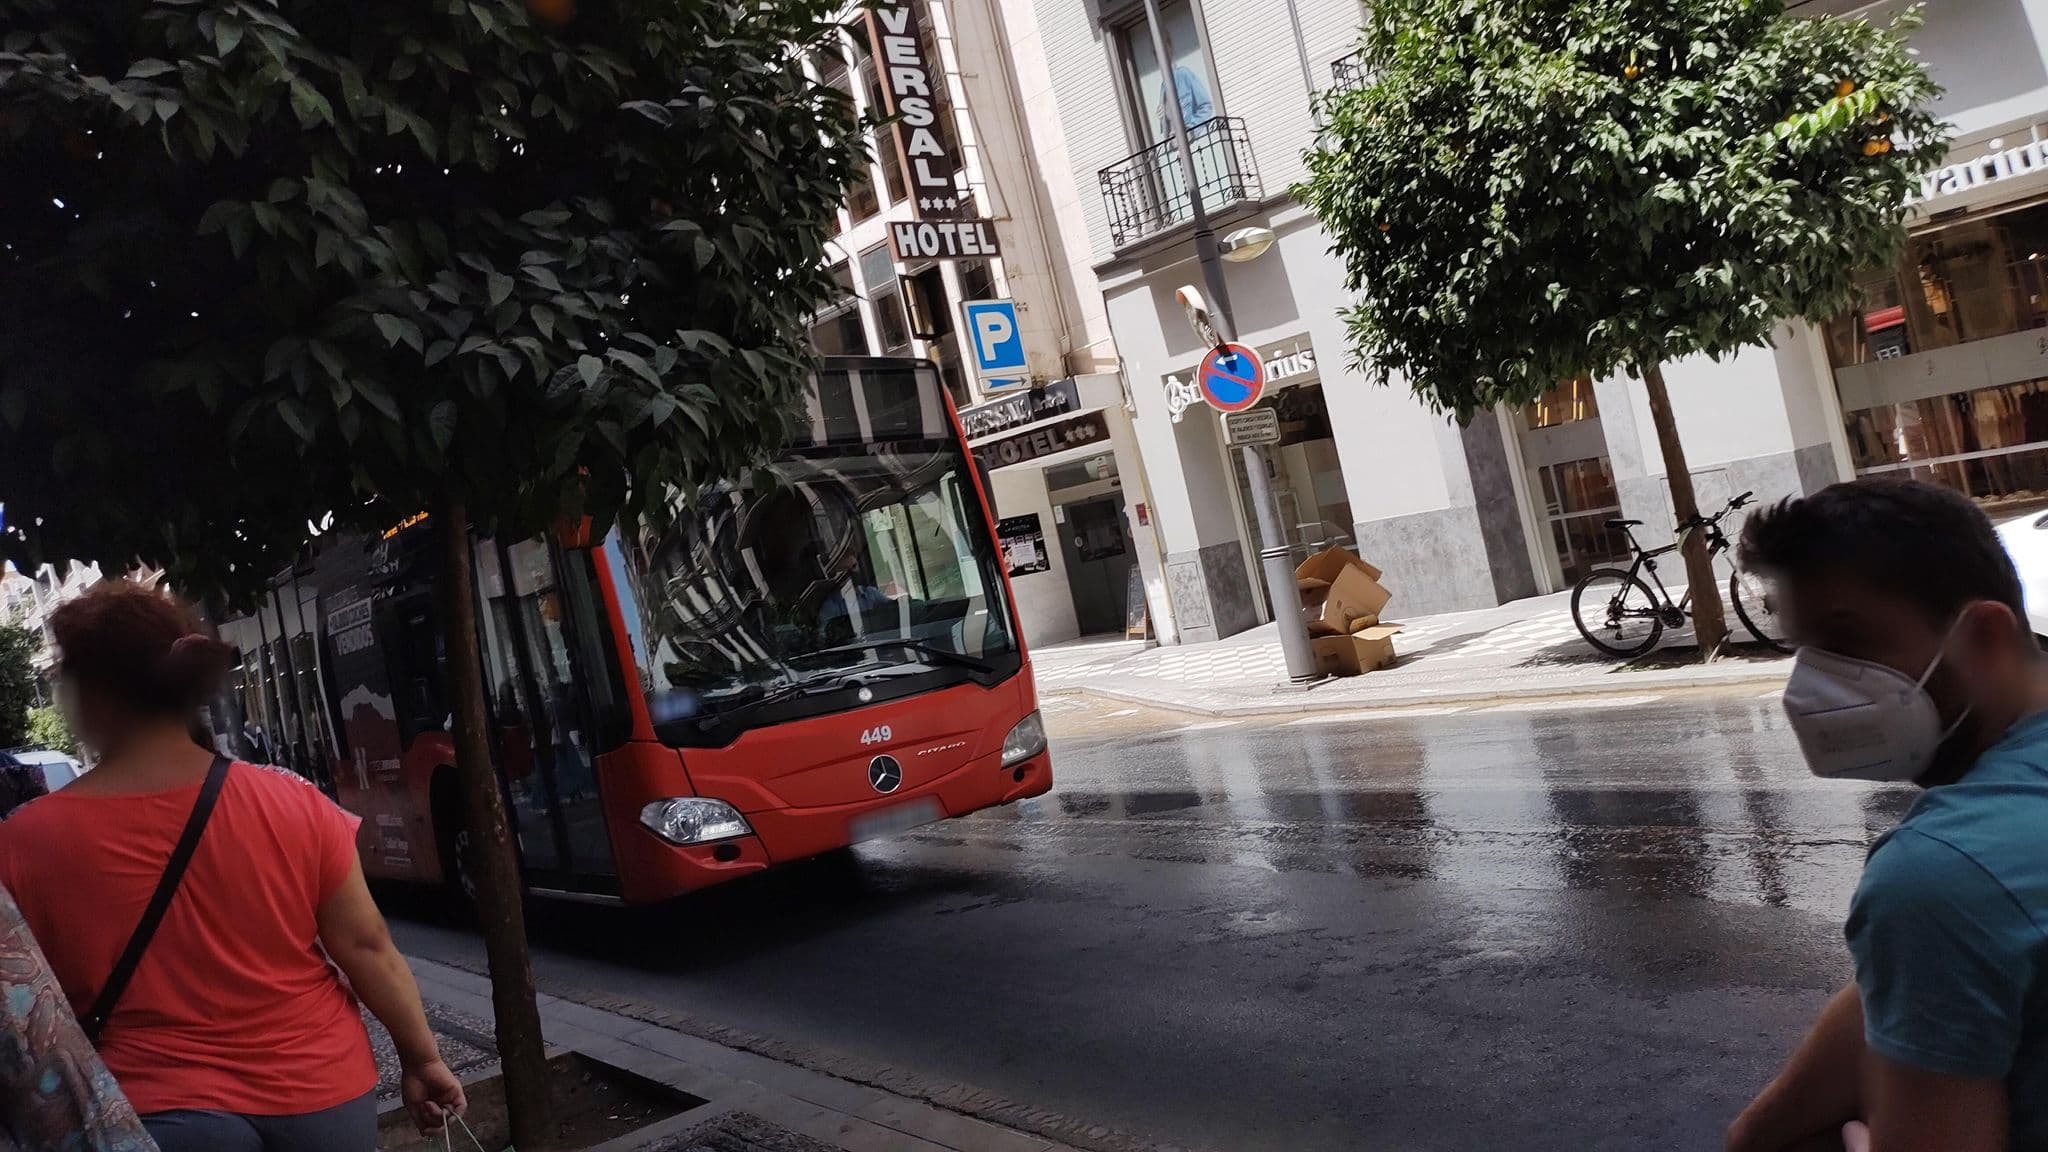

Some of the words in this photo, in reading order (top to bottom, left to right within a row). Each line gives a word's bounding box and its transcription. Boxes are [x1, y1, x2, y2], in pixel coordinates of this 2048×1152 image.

[877, 0, 949, 188] VERSAL
[894, 221, 997, 258] HOTEL
[975, 311, 1012, 361] P
[961, 396, 1033, 438] VERSAL
[981, 429, 1066, 470] HOTEL
[860, 724, 892, 747] 449
